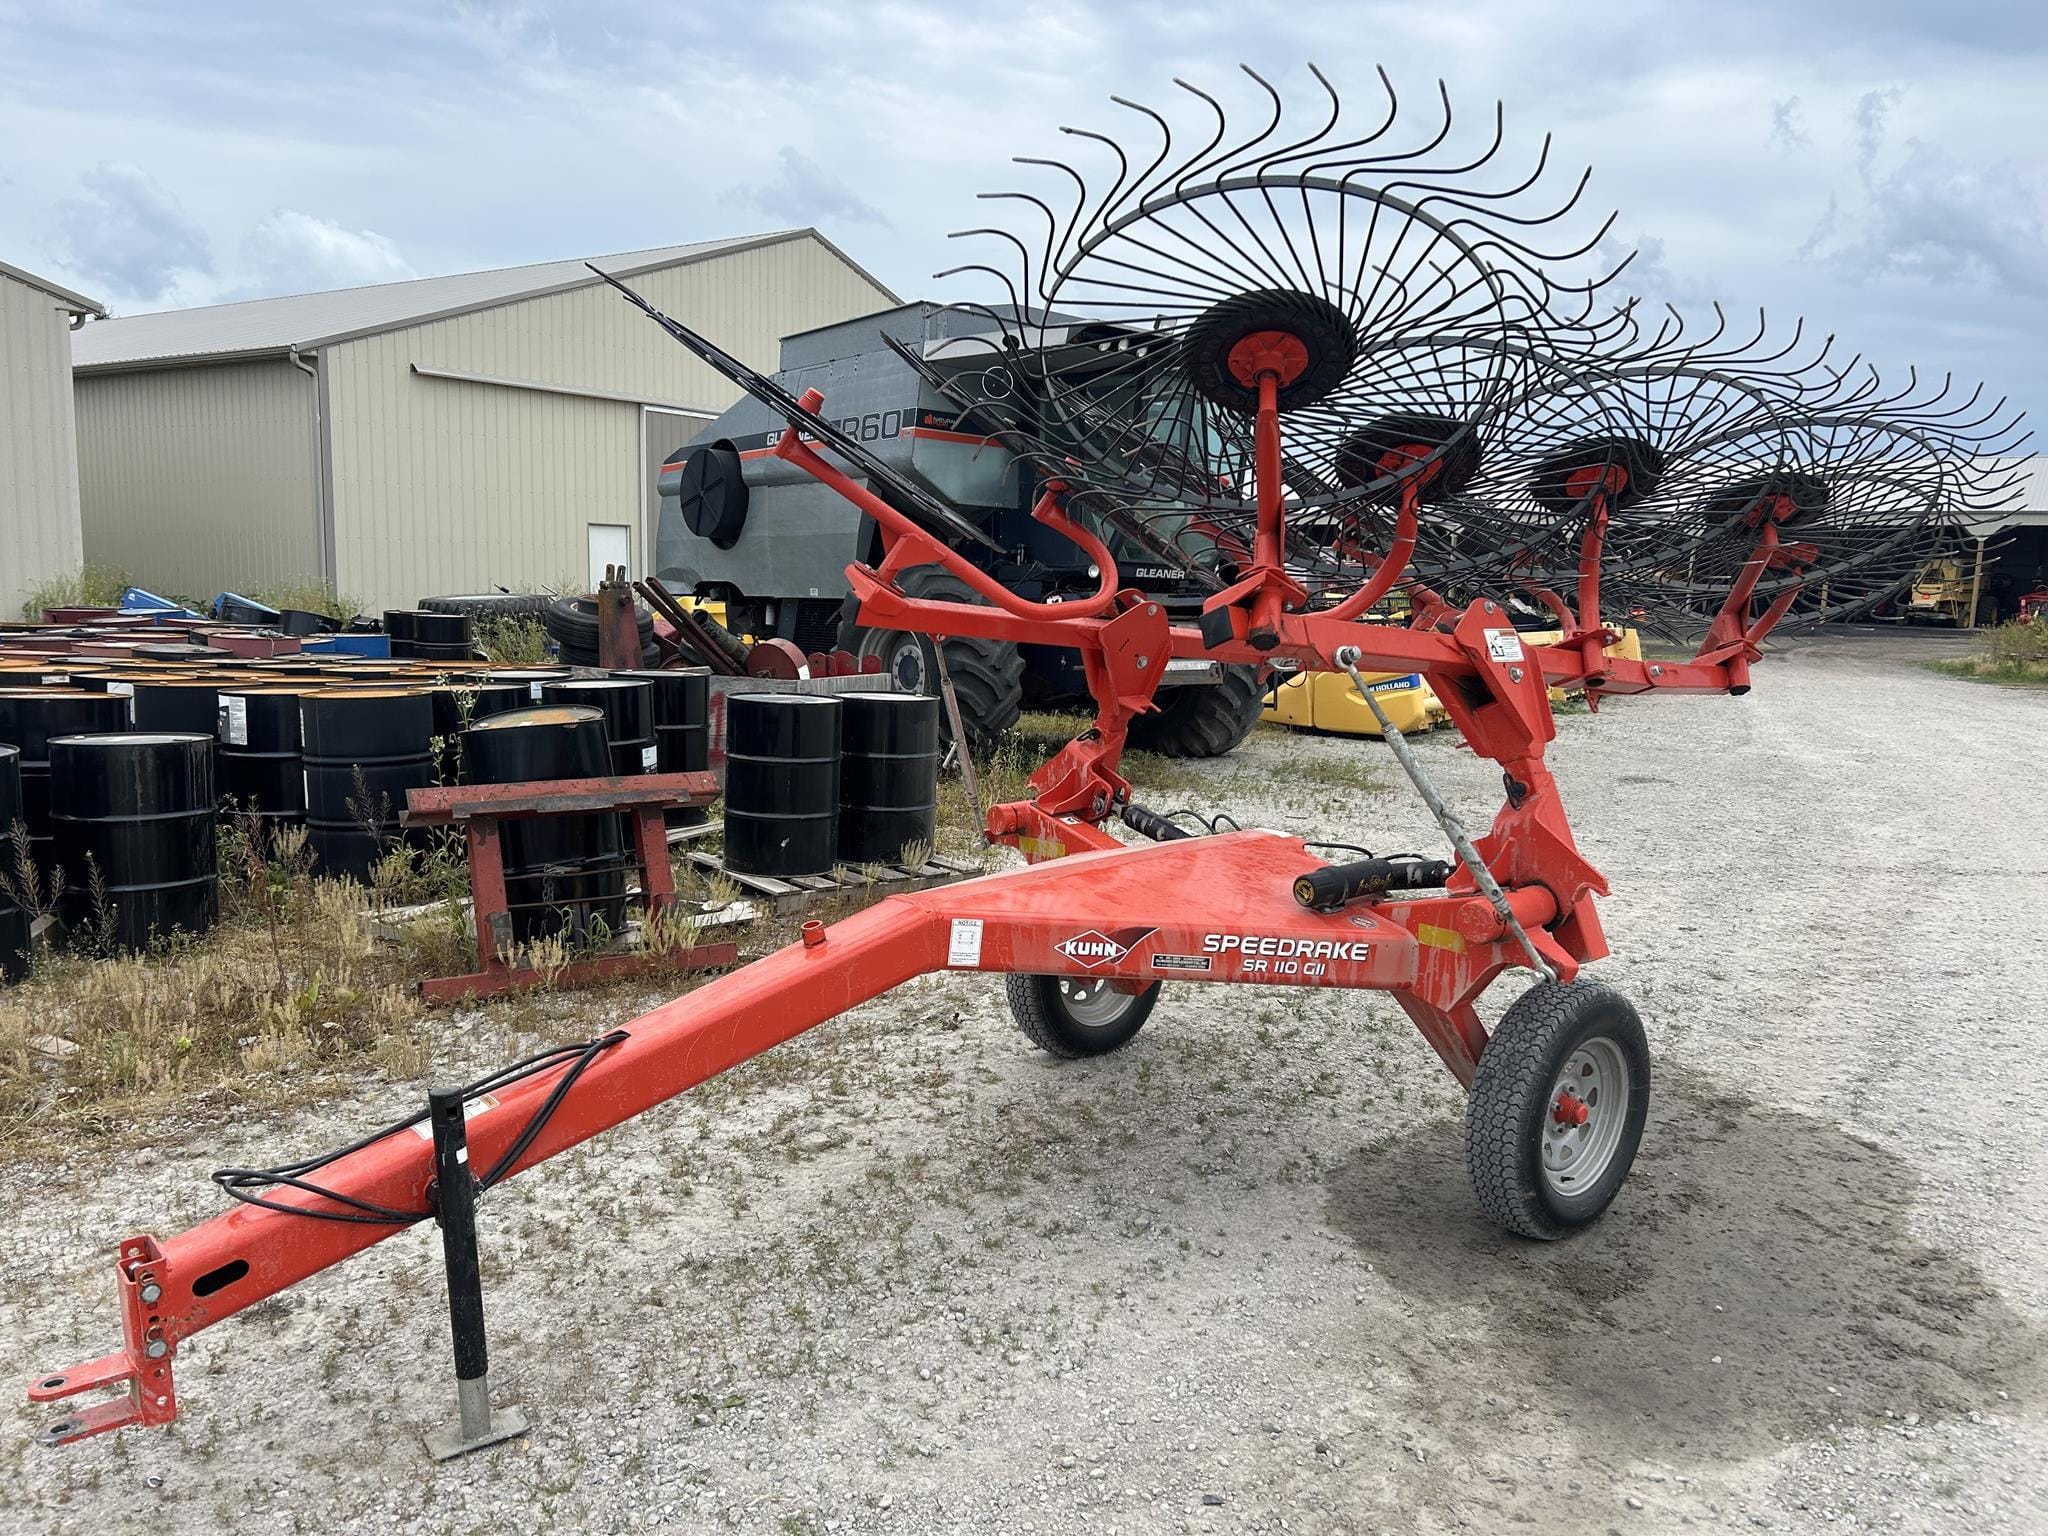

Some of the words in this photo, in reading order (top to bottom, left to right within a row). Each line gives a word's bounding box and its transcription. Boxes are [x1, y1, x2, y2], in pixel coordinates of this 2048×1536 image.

[1136, 567, 1185, 579] GLEANER
[1375, 681, 1410, 691] HOLLAND
[1064, 941, 1116, 956] KUHN
[1203, 934, 1369, 961] SPEEDRAKE
[1242, 959, 1268, 973] SR
[1273, 962, 1298, 974] 110
